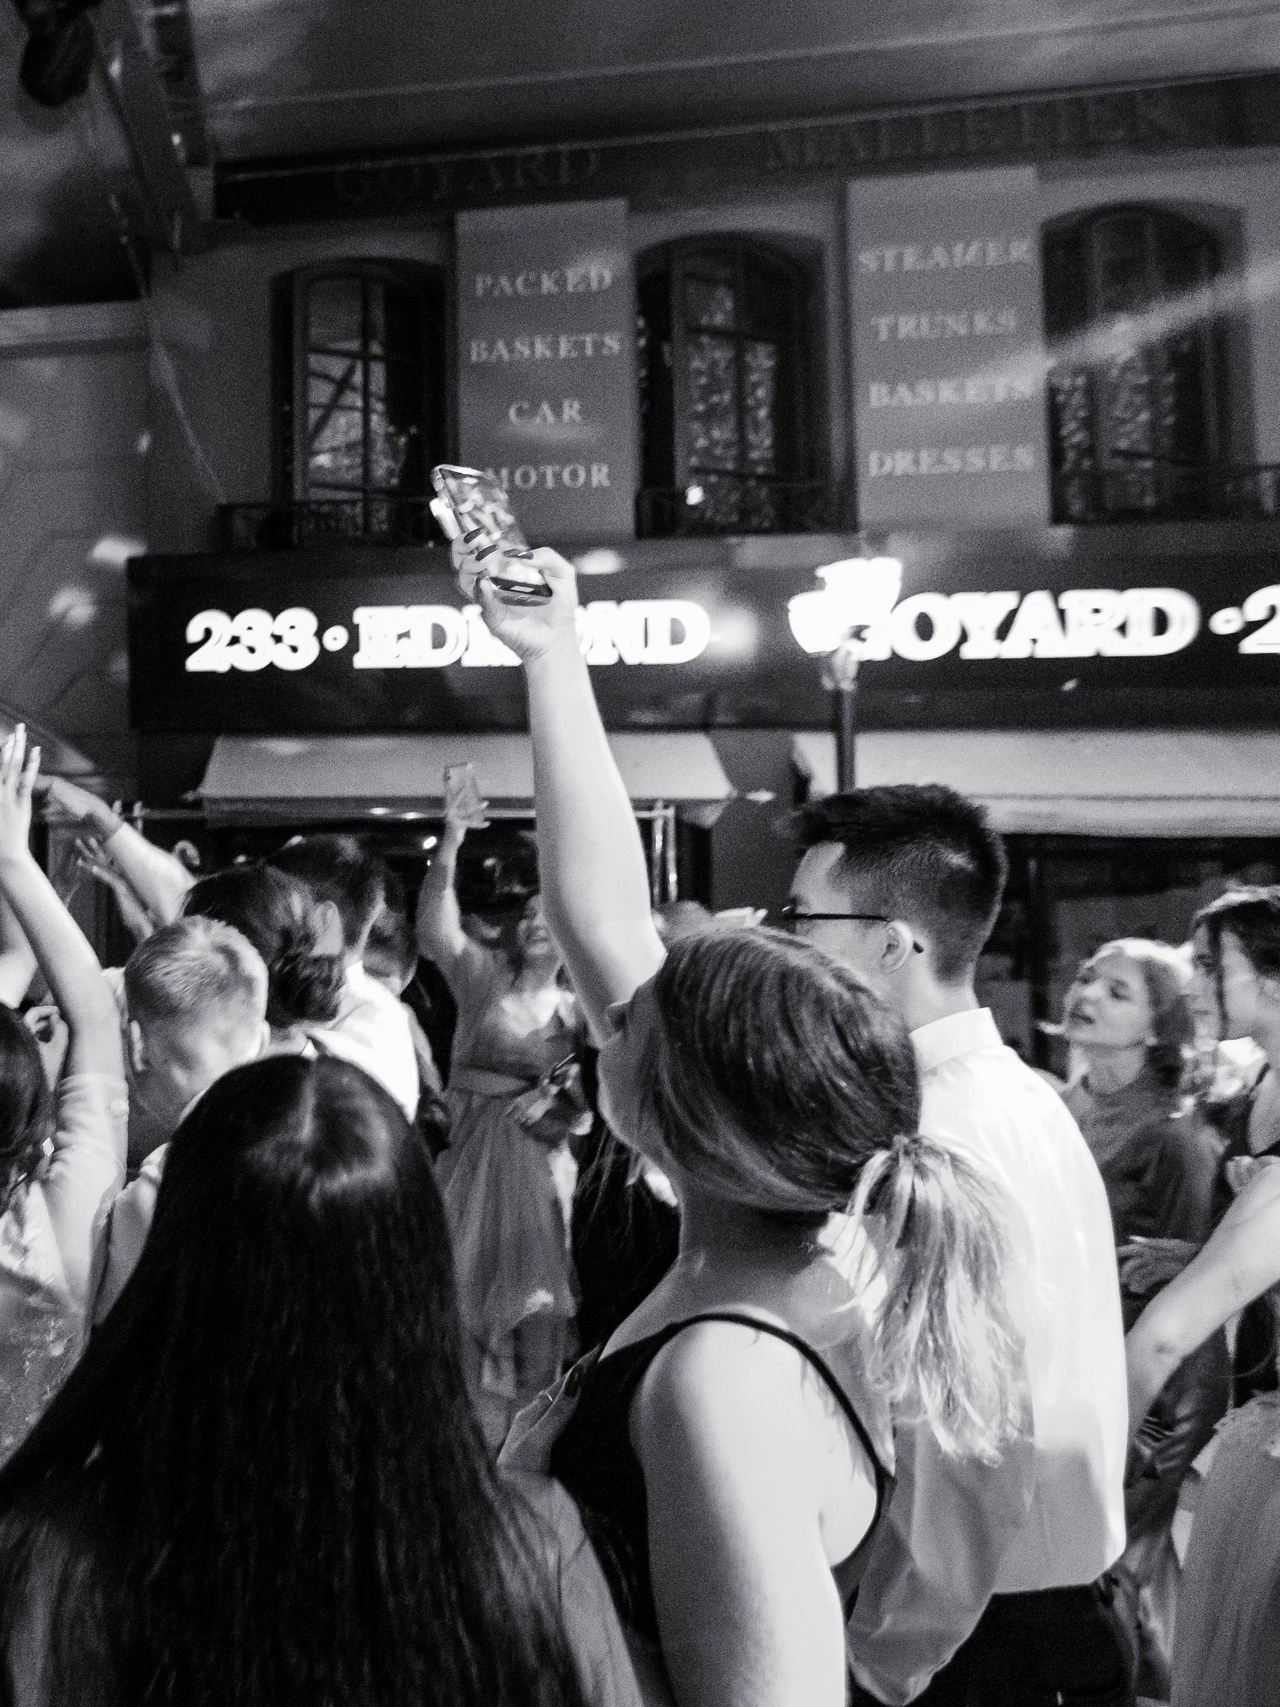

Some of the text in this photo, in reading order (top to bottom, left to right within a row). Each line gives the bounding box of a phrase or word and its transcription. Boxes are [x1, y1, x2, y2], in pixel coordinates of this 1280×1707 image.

[475, 266, 613, 297] PACKED
[469, 331, 623, 363] BASKETS
[868, 374, 1036, 407] BASKETS
[507, 399, 584, 427] CAR
[868, 444, 1037, 478] DRESSES
[186, 607, 321, 673] 233
[353, 600, 712, 669] EDND
